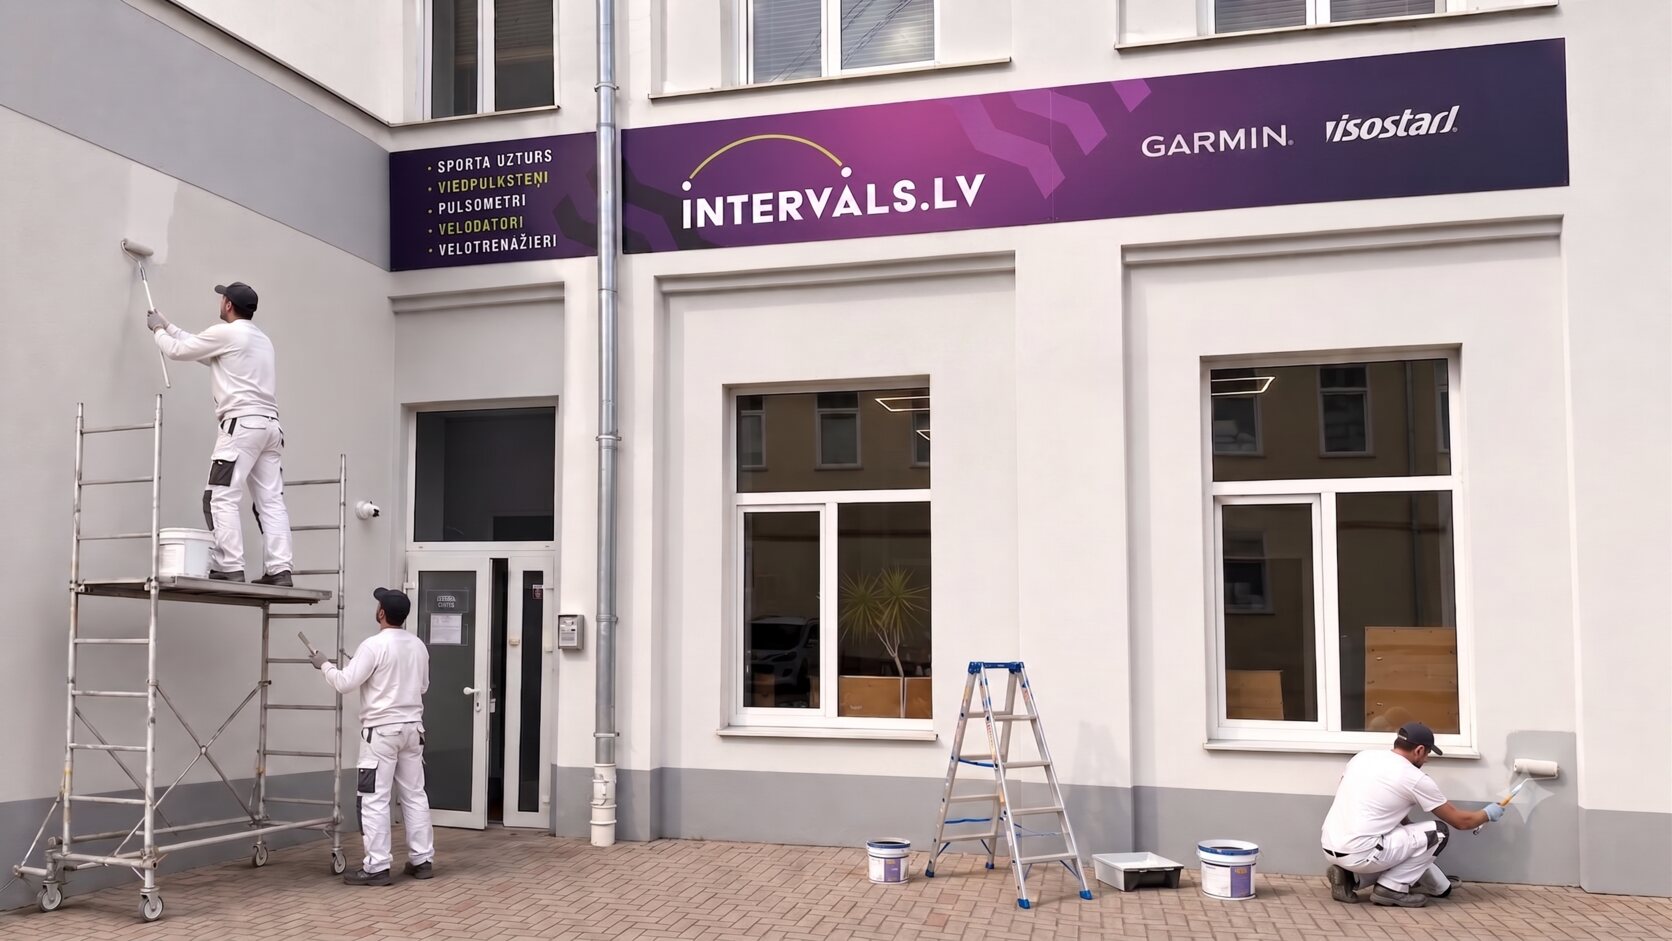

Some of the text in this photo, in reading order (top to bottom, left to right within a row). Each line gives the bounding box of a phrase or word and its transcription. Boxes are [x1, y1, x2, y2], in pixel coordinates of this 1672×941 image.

[1141, 124, 1287, 158] GARMIN
[437, 149, 552, 173] SPORTA UZTURS
[438, 171, 548, 194] VIEDPULKSTEŅI
[438, 193, 526, 215] PULSOMETRI
[438, 216, 523, 236] VELODATORI
